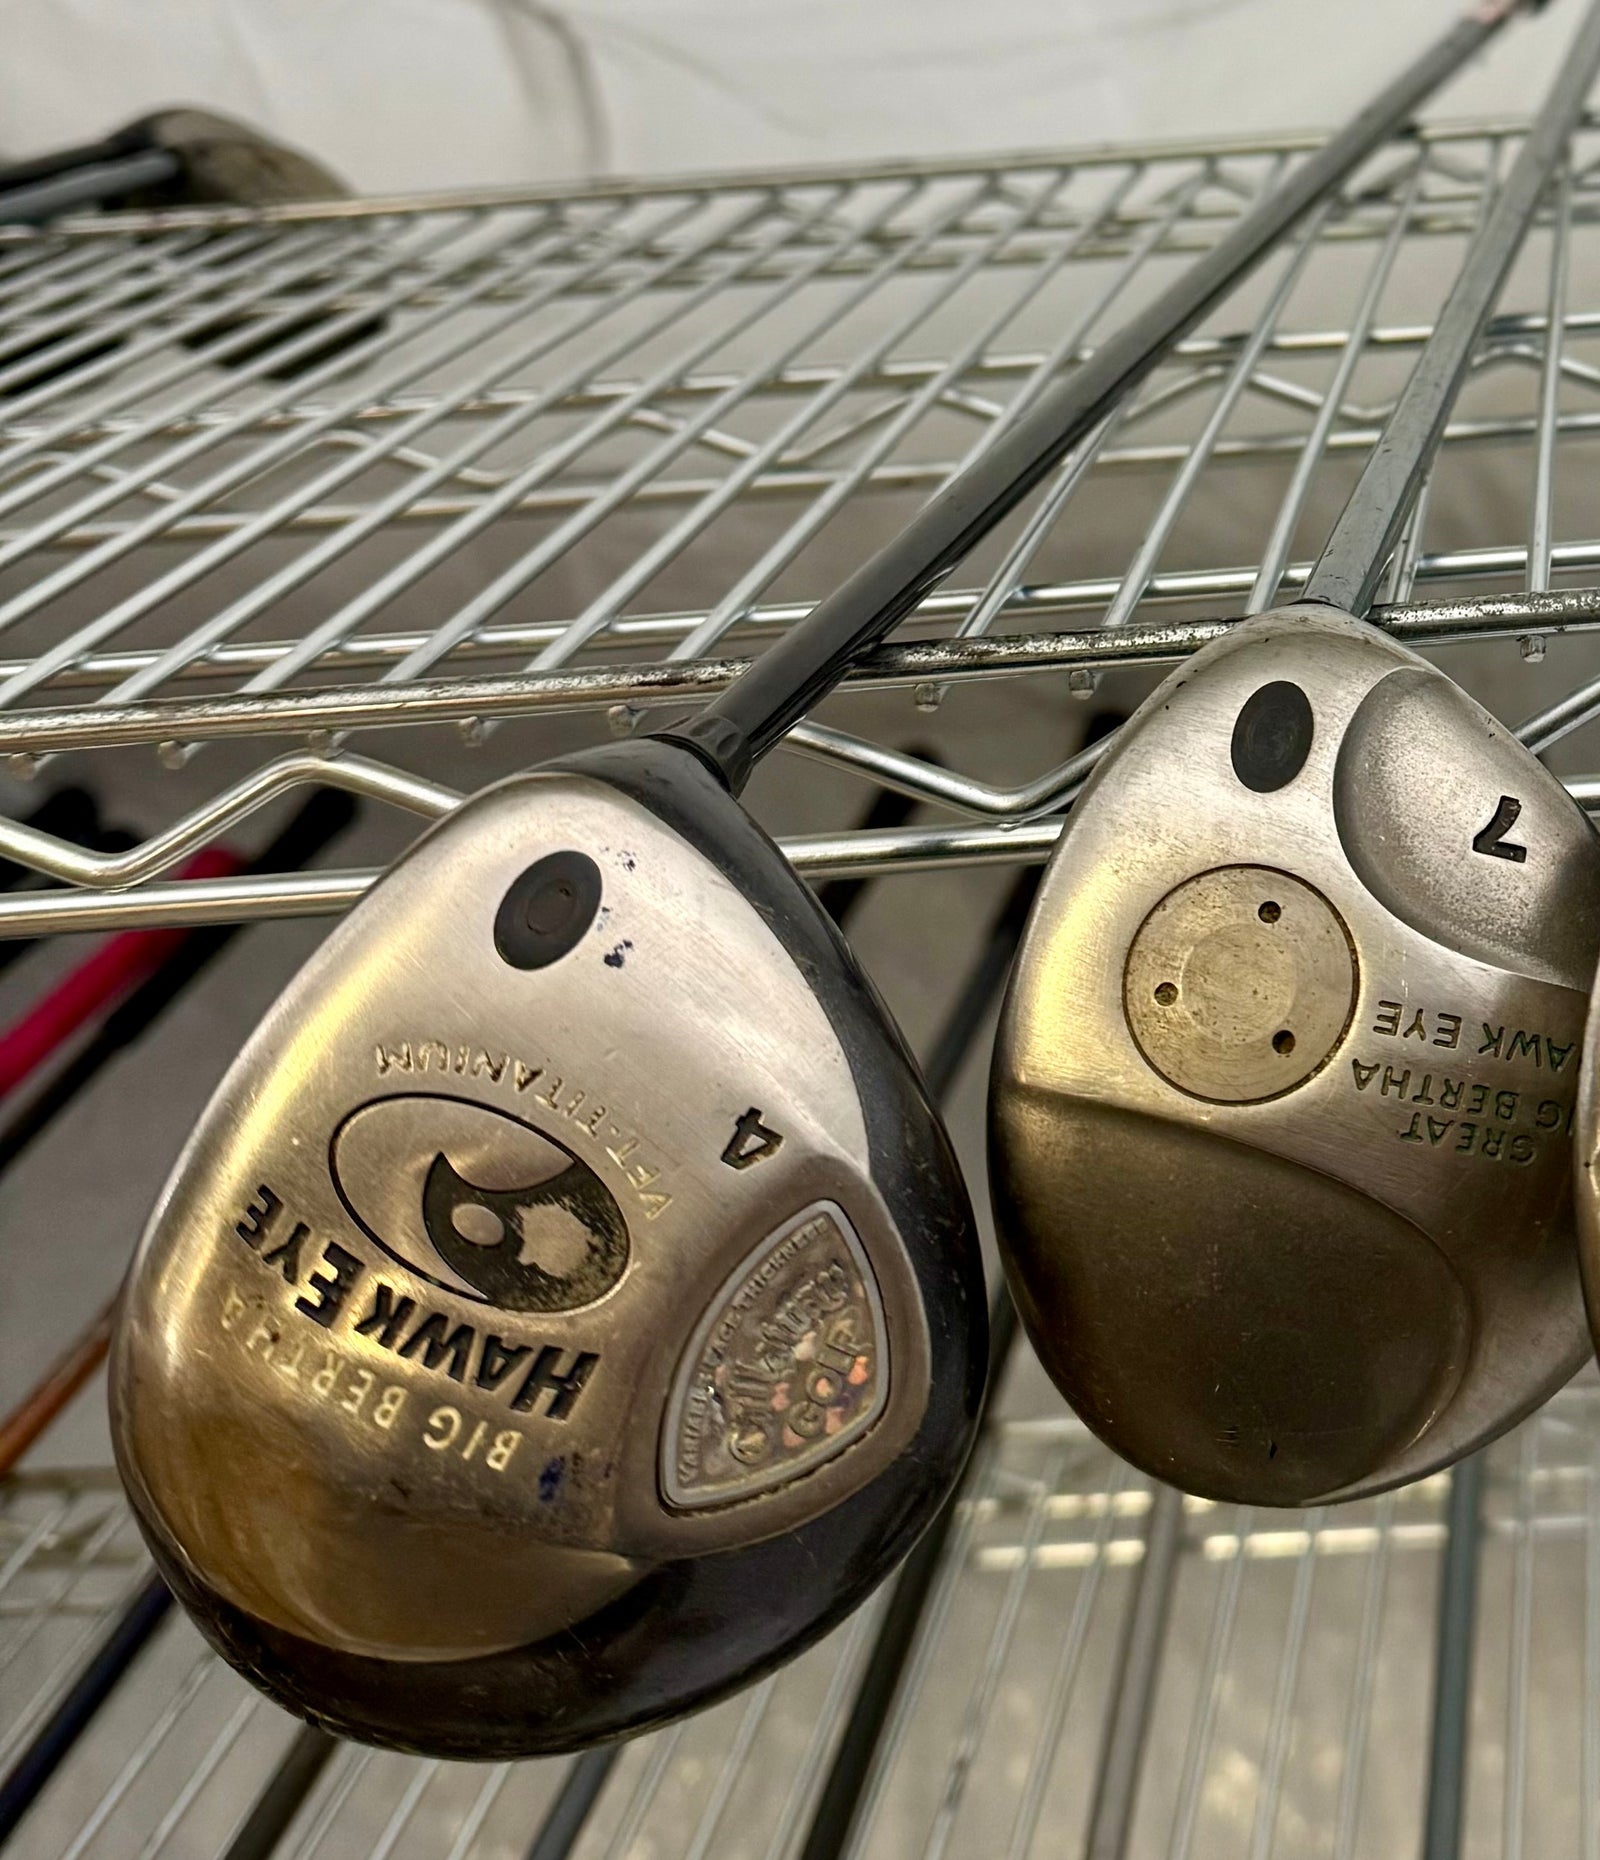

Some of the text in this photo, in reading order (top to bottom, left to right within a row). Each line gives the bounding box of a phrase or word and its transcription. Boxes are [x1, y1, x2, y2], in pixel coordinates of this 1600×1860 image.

[1472, 795, 1527, 863] 7
[1372, 1000, 1577, 1073] AWK EYE
[1352, 1058, 1576, 1137] IG BERTHA
[721, 1106, 785, 1171] 4
[1400, 1112, 1538, 1166] GREAT
[218, 1287, 524, 1473] BIG BERTHA
[786, 1306, 873, 1440] GOLF
